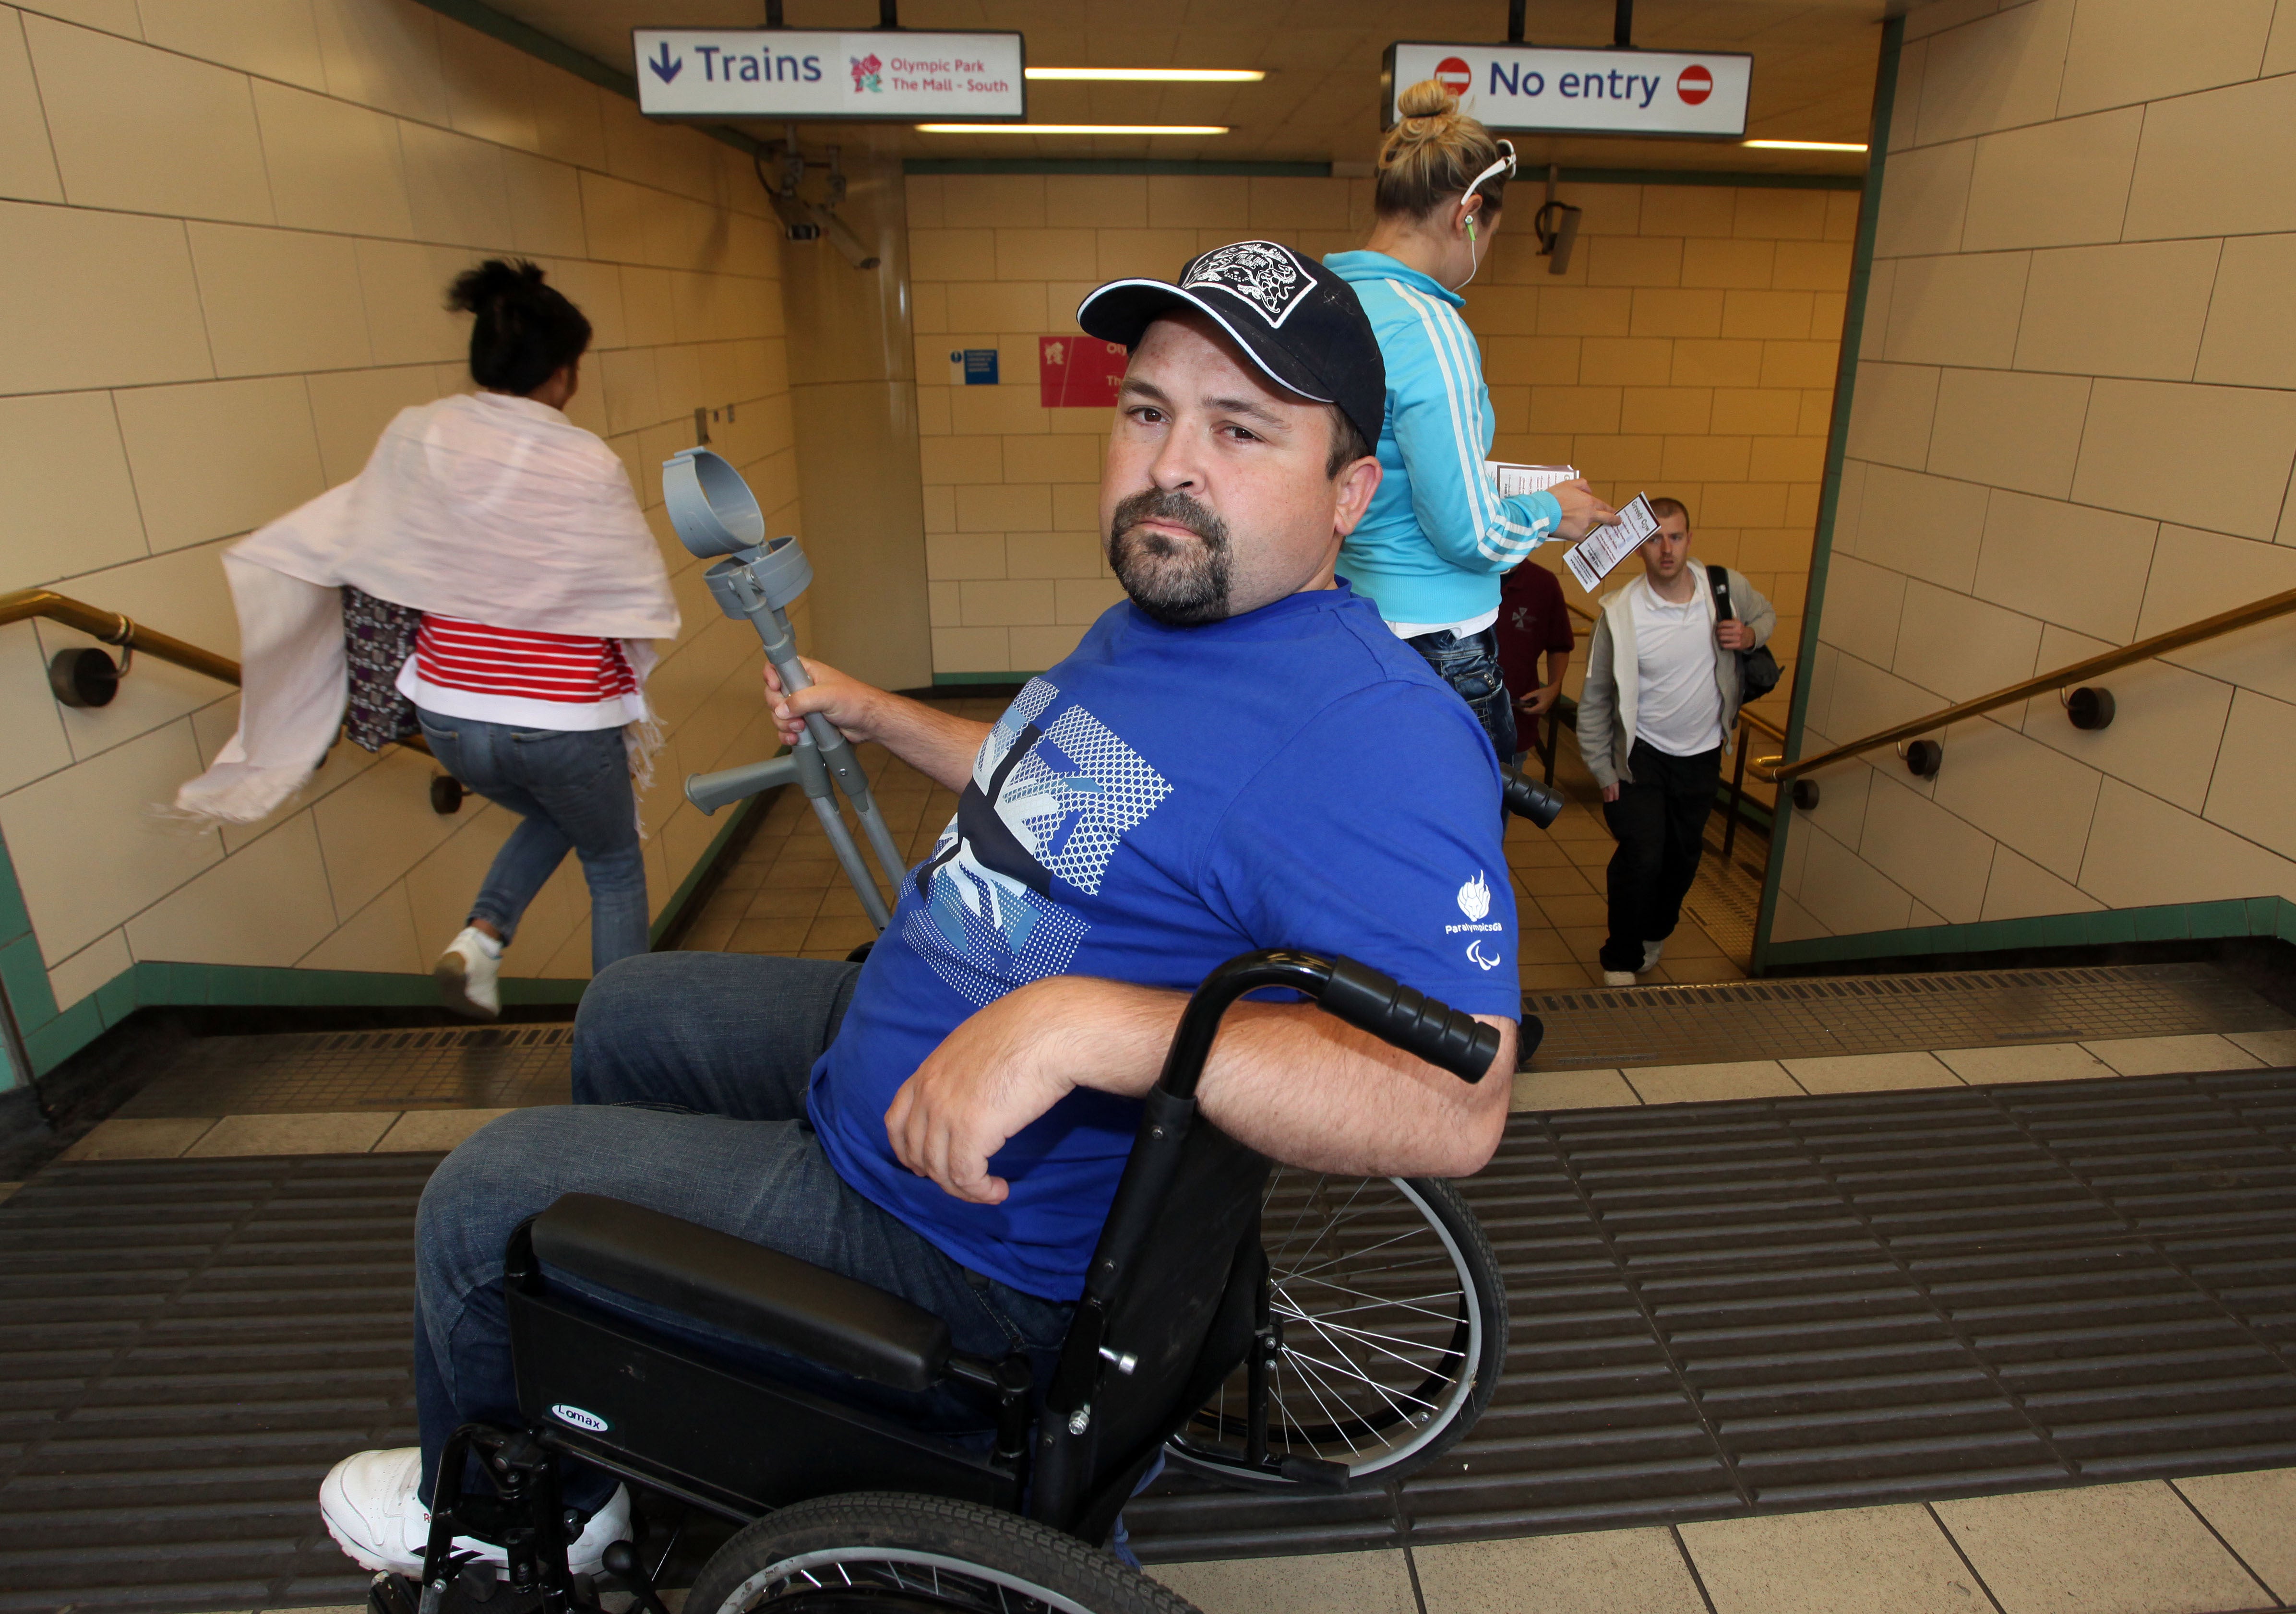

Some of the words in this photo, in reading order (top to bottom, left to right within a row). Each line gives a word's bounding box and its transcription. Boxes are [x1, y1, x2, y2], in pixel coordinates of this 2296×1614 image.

[694, 46, 822, 82] Trains
[891, 57, 950, 74] Olympic
[955, 59, 985, 73] Park
[891, 77, 919, 91] The
[922, 78, 953, 91] Mall
[967, 79, 1009, 93] South
[1489, 62, 1545, 97] No
[1559, 69, 1661, 109] entry
[1632, 501, 1643, 520] Greedy
[1445, 922, 1502, 935] ParalympicsGB
[559, 1405, 600, 1429] Lomax
